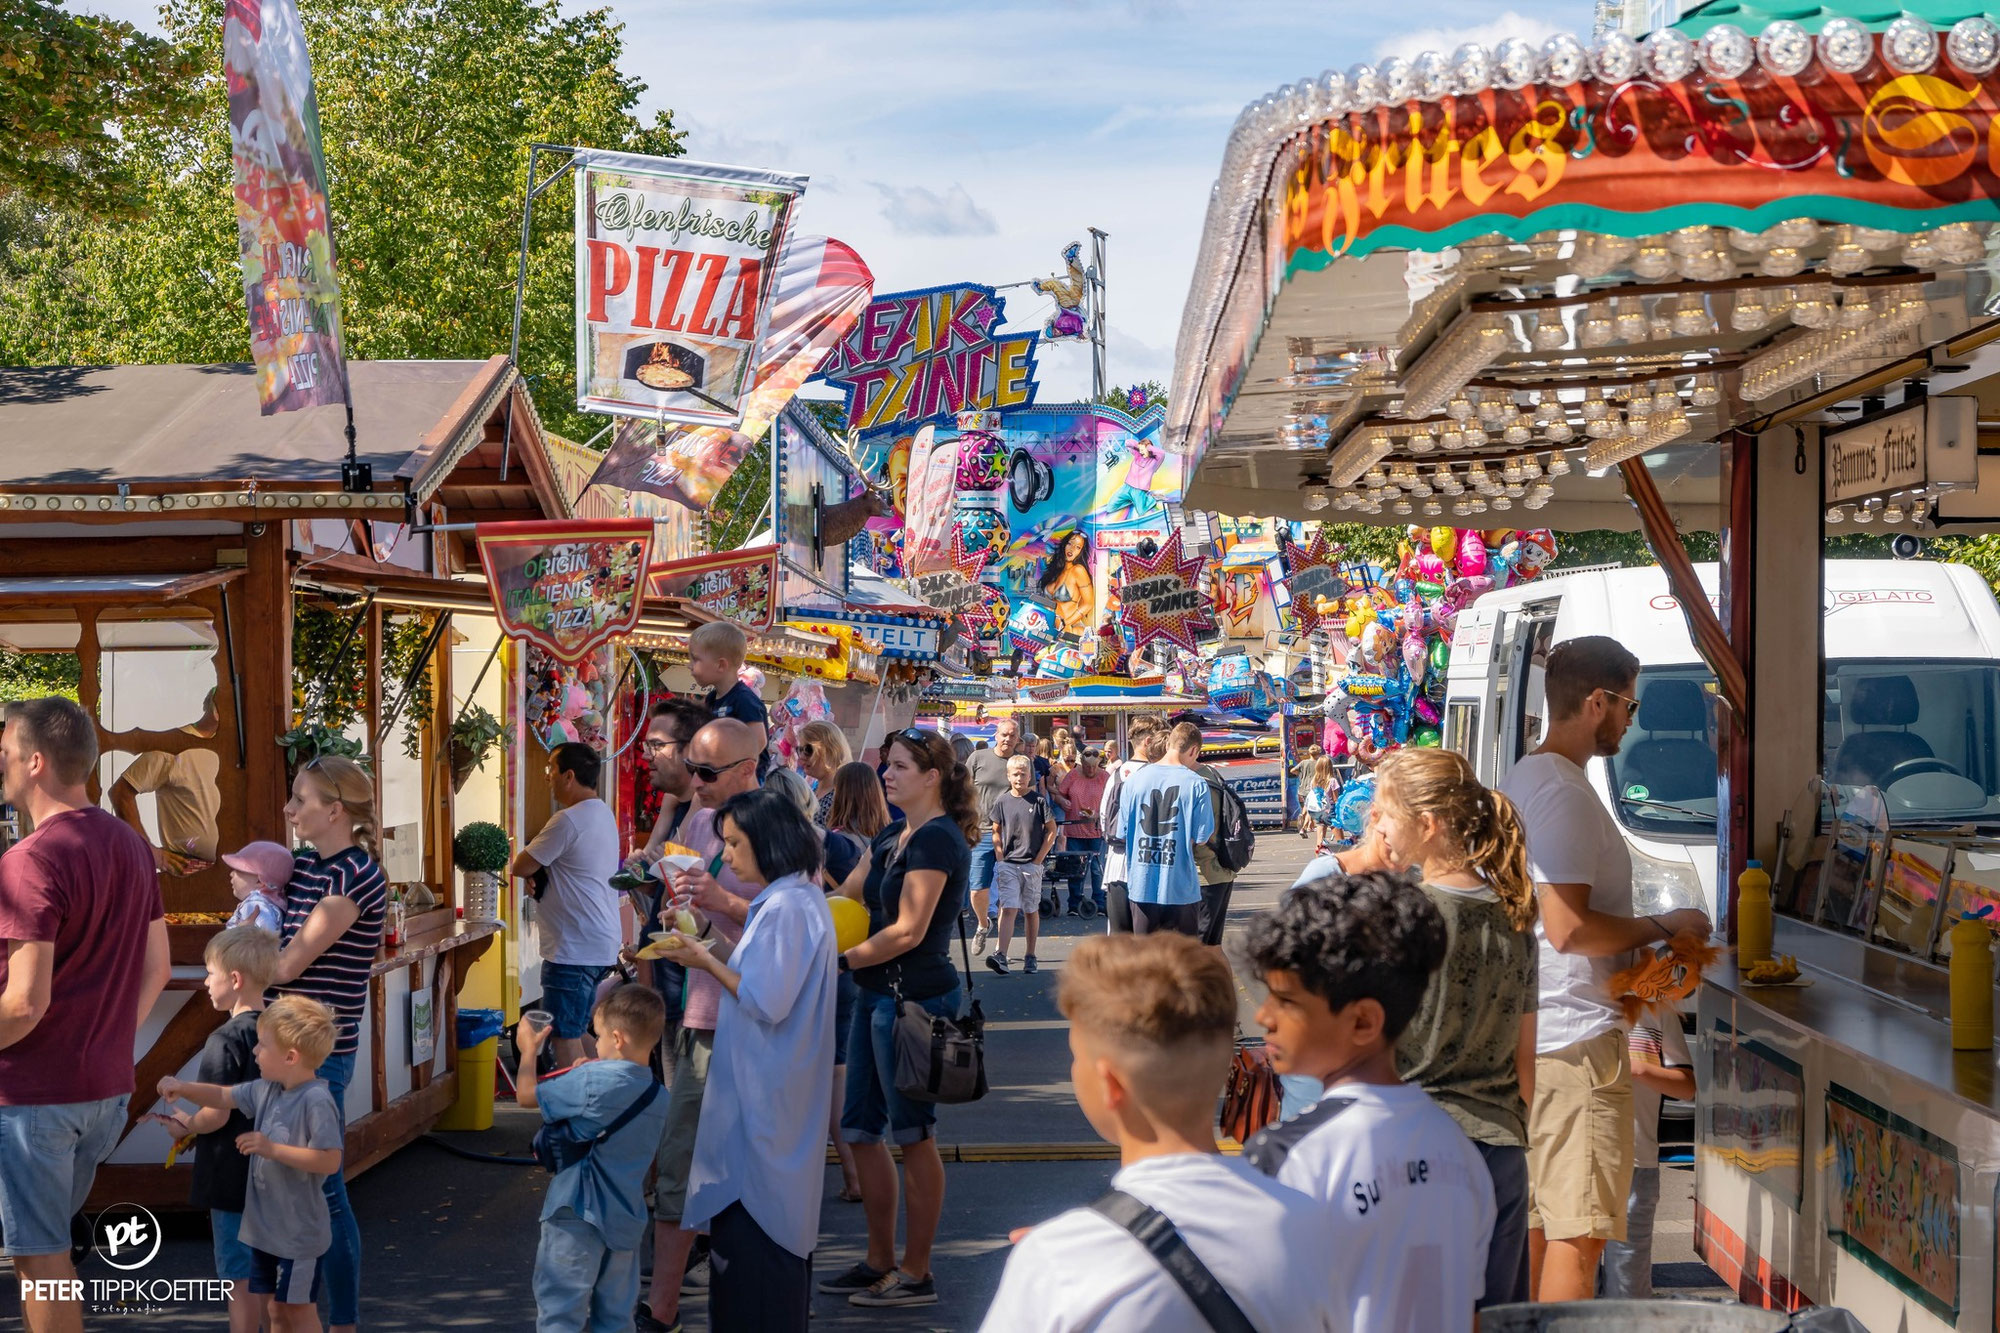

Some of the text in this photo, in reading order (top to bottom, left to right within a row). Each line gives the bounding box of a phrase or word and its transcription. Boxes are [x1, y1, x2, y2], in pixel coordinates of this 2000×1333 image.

[594, 192, 773, 250] Ofenfrische
[586, 239, 761, 341] PIZZA
[811, 289, 987, 376] REAK
[843, 338, 1031, 431] DANCE
[1832, 426, 1917, 497] Pommes Frites
[634, 460, 684, 488] PIZZA
[523, 546, 609, 580] ORIGINAL
[506, 574, 632, 608] ITALIENISCHE
[1122, 579, 1172, 603] BREAK
[1148, 590, 1199, 614] DANCE
[1838, 591, 1933, 603] GELATO
[544, 608, 595, 631] PIZZA
[1027, 612, 1039, 626] 9
[1064, 649, 1081, 669] 15
[1220, 663, 1236, 678] 13
[1029, 684, 1070, 701] Mandeln
[1243, 778, 1282, 791] Contro
[1138, 837, 1177, 852] CLEAR
[1138, 850, 1175, 866] SKIES
